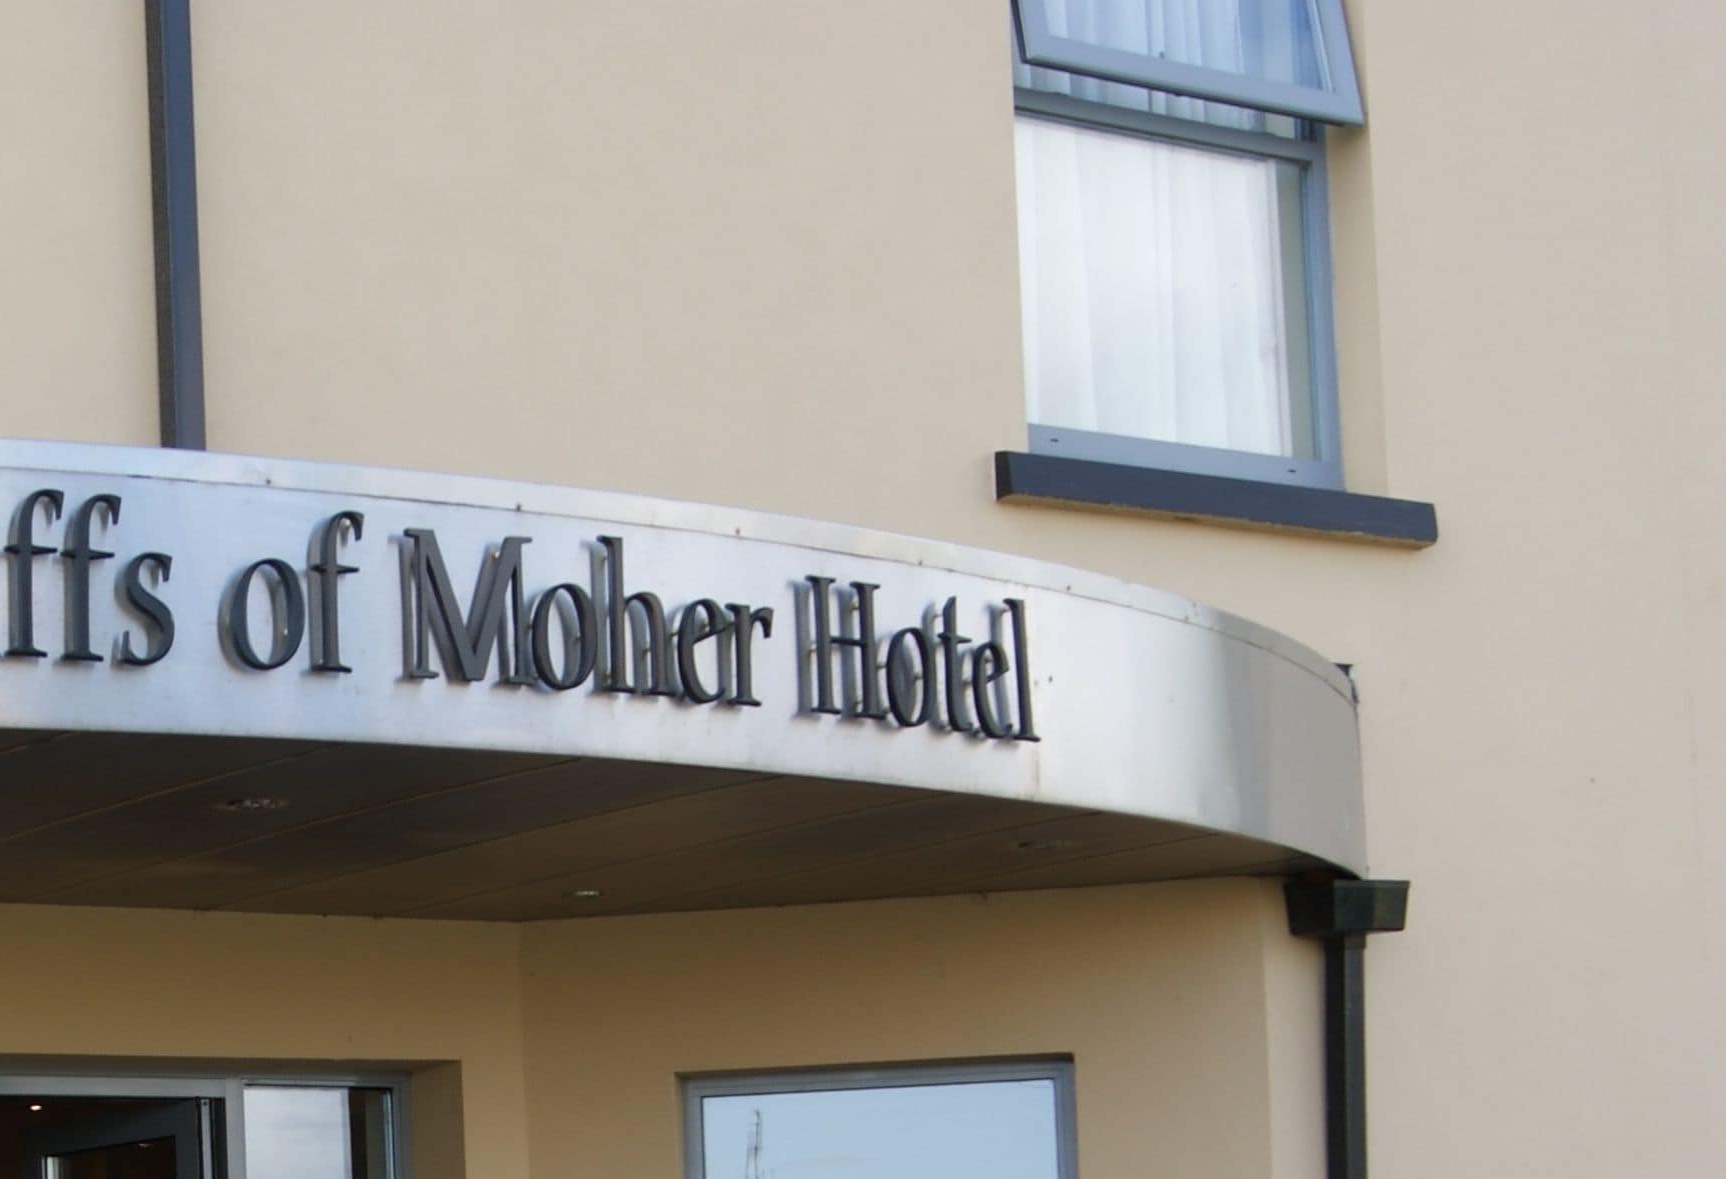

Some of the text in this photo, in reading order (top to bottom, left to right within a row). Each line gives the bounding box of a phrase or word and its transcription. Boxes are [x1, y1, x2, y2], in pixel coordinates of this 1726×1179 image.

[222, 510, 365, 673] of
[398, 527, 774, 706] Moher
[800, 574, 1041, 743] Hotel
